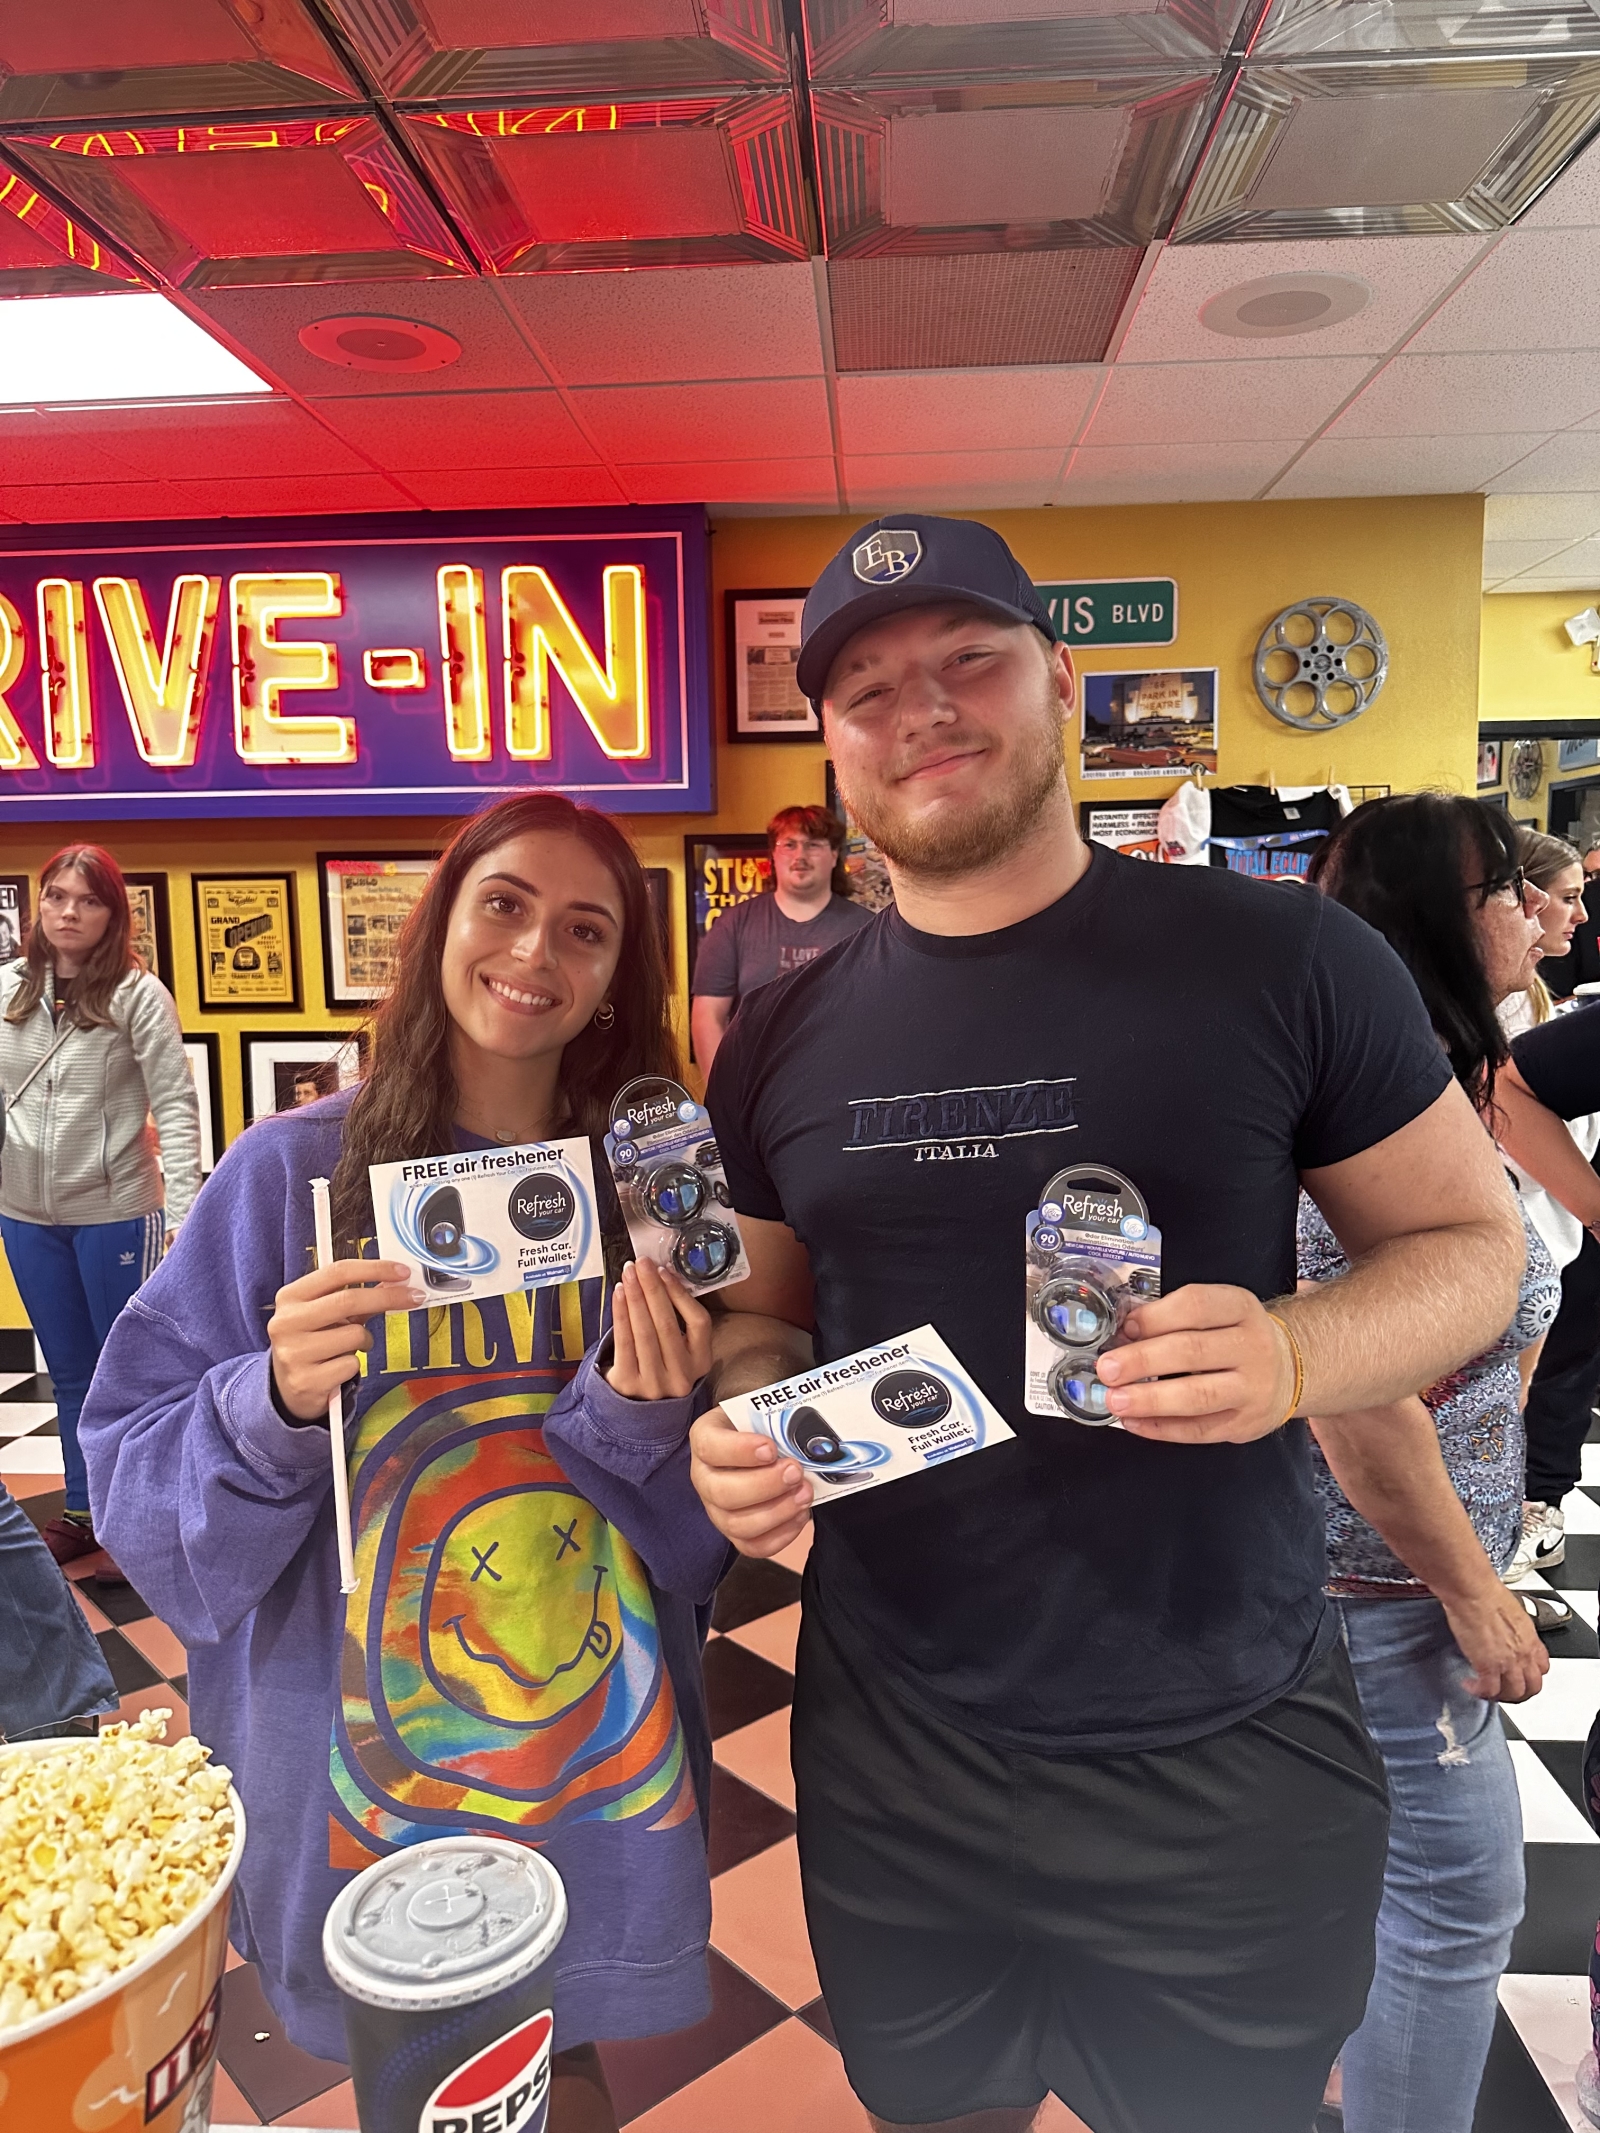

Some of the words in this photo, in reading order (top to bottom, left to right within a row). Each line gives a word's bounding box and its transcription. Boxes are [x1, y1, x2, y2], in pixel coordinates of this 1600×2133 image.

[861, 539, 909, 576] EB
[1112, 603, 1164, 623] BLVD
[1225, 849, 1268, 875] TOTAL
[211, 916, 240, 925] GRAND
[627, 1096, 676, 1126] Refresh
[650, 1115, 665, 1124] your
[846, 1084, 1076, 1144] FIRENZE
[620, 1149, 632, 1159] 90
[914, 1143, 999, 1162] ITALIA
[402, 1161, 448, 1181] FREE
[453, 1158, 478, 1174] air
[481, 1148, 564, 1170] freshener
[517, 1192, 567, 1218] Refresh
[538, 1209, 553, 1217] your
[1063, 1194, 1123, 1220] Refresh
[1088, 1214, 1106, 1222] your
[1040, 1234, 1055, 1244] 90
[519, 1244, 548, 1257] Fresh
[550, 1242, 572, 1252] Car.
[517, 1257, 536, 1268] Full
[750, 1385, 797, 1411] FREE
[799, 1377, 822, 1394] air
[823, 1344, 910, 1385] freshener
[827, 1384, 845, 1394] Refresh
[881, 1382, 938, 1412] Refresh
[911, 1400, 926, 1409] your
[927, 1394, 938, 1402] car
[908, 1428, 940, 1444] Fresh
[940, 1421, 964, 1432] Car.
[911, 1440, 932, 1453] Full
[432, 2053, 552, 2133] PEPS
